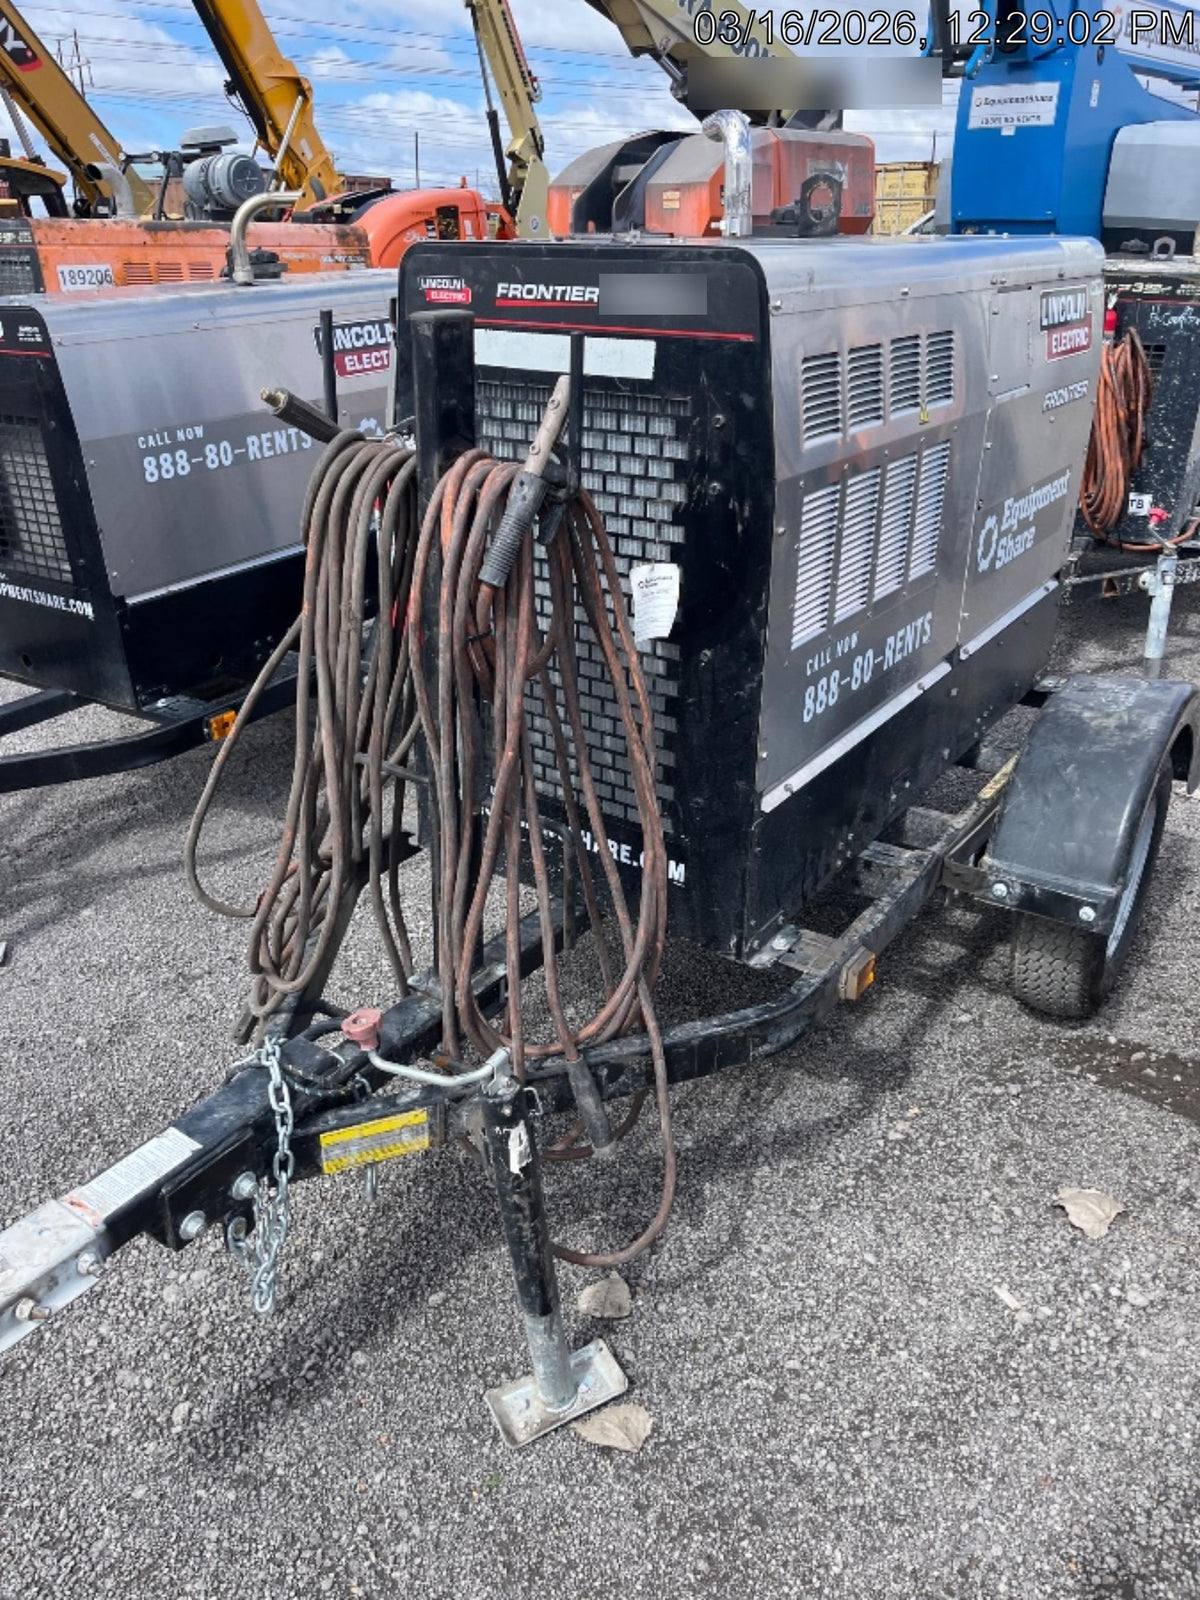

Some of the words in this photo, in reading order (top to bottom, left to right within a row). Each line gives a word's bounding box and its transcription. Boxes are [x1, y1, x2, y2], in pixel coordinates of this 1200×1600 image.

[59, 267, 114, 287] 189206
[420, 278, 461, 290] LINCOLN
[496, 282, 600, 303] FRONTIER
[1041, 293, 1086, 326] LINCOLN
[1051, 327, 1089, 353] ELECTRIC
[344, 349, 390, 371] ELECT
[138, 431, 172, 449] CALL
[177, 425, 204, 442] NOW
[143, 427, 313, 483] 888-80-RENTS
[1001, 468, 1071, 532] Equipment
[996, 525, 1036, 570] Share
[803, 611, 933, 723] 888-80-RENTS
[806, 646, 831, 677] CALL
